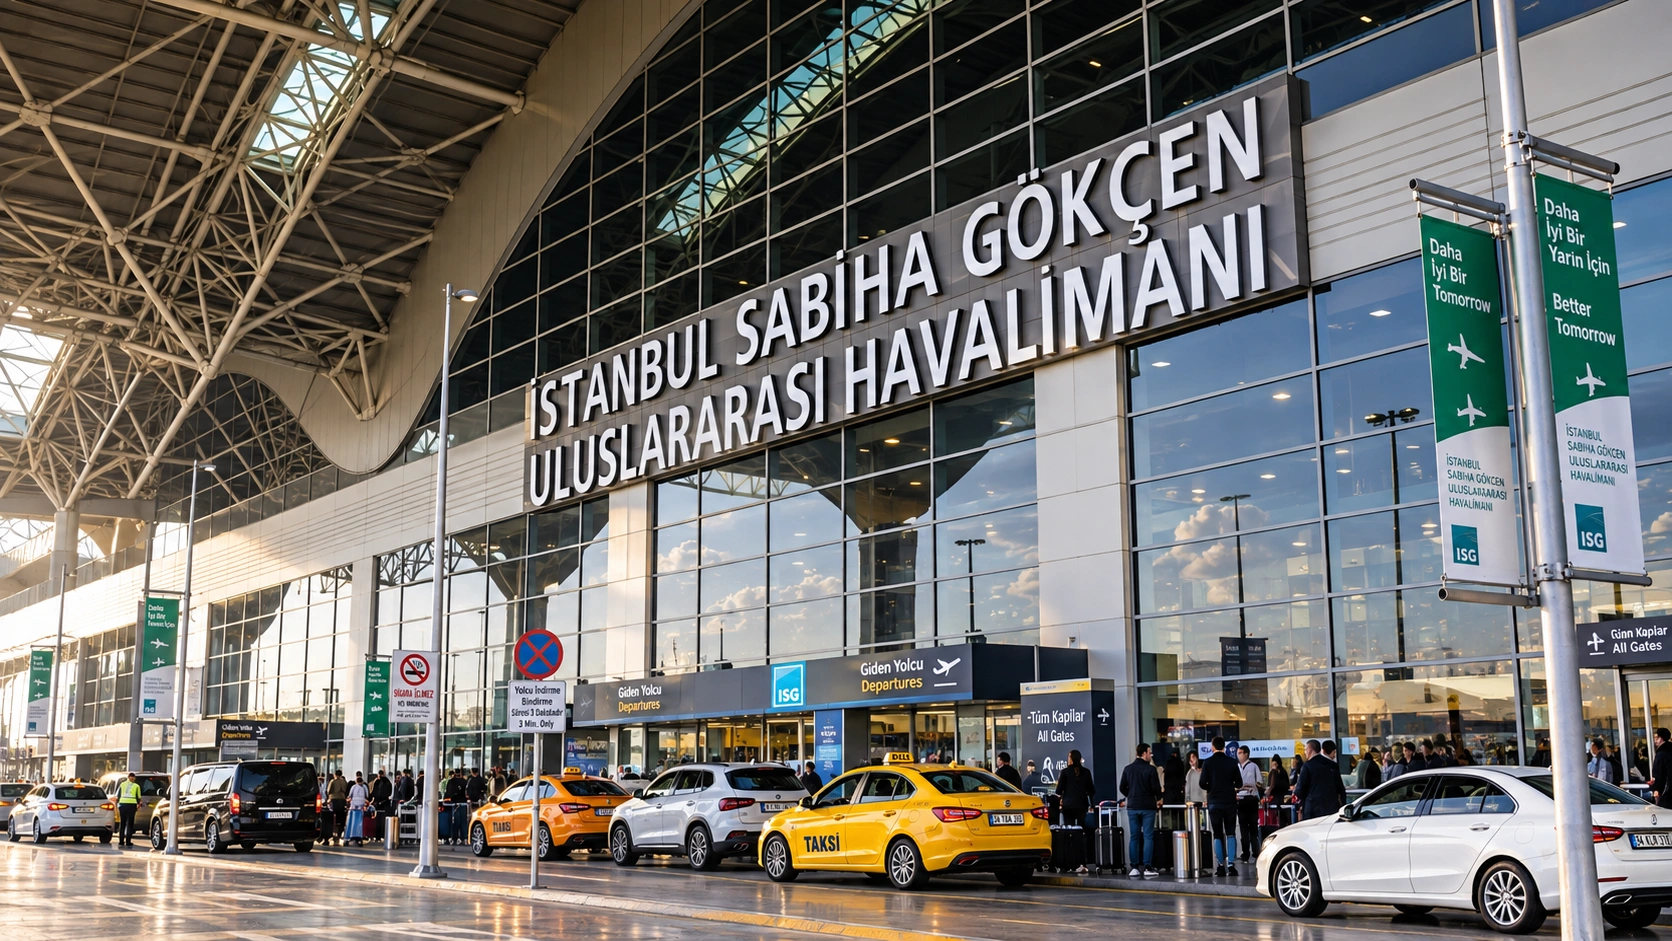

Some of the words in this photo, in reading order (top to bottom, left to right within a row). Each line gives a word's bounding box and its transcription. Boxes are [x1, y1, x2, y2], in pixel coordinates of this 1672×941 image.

[1544, 197, 1580, 222] Daha
[1546, 216, 1563, 243] İyi
[1566, 226, 1585, 246] Bir
[1430, 237, 1462, 262] Daha
[531, 318, 721, 440] İSTANBUL
[736, 231, 941, 366] SABİHA
[962, 96, 1262, 277] GÖKÇEN
[1431, 257, 1447, 282] İyi
[1450, 265, 1467, 285] Bir
[1586, 250, 1611, 277] İçin
[1432, 283, 1491, 313] Tomorrow
[1552, 292, 1592, 317] Better
[1554, 316, 1616, 346] Tomorrow
[530, 356, 827, 506] ULUSLARARASI
[846, 204, 1266, 414] HAVALİMANI
[1581, 530, 1604, 549] ISG
[1456, 547, 1477, 562] ISG
[1612, 642, 1627, 654] All
[1630, 641, 1662, 652] Gates
[860, 661, 891, 676] Giden
[893, 657, 924, 673] Yolcu
[778, 687, 800, 703] ISG
[861, 677, 923, 695] Departures
[540, 720, 554, 730] Only
[1037, 730, 1048, 742] All
[1050, 729, 1075, 742] Gates
[803, 832, 840, 853] TAKSİ
